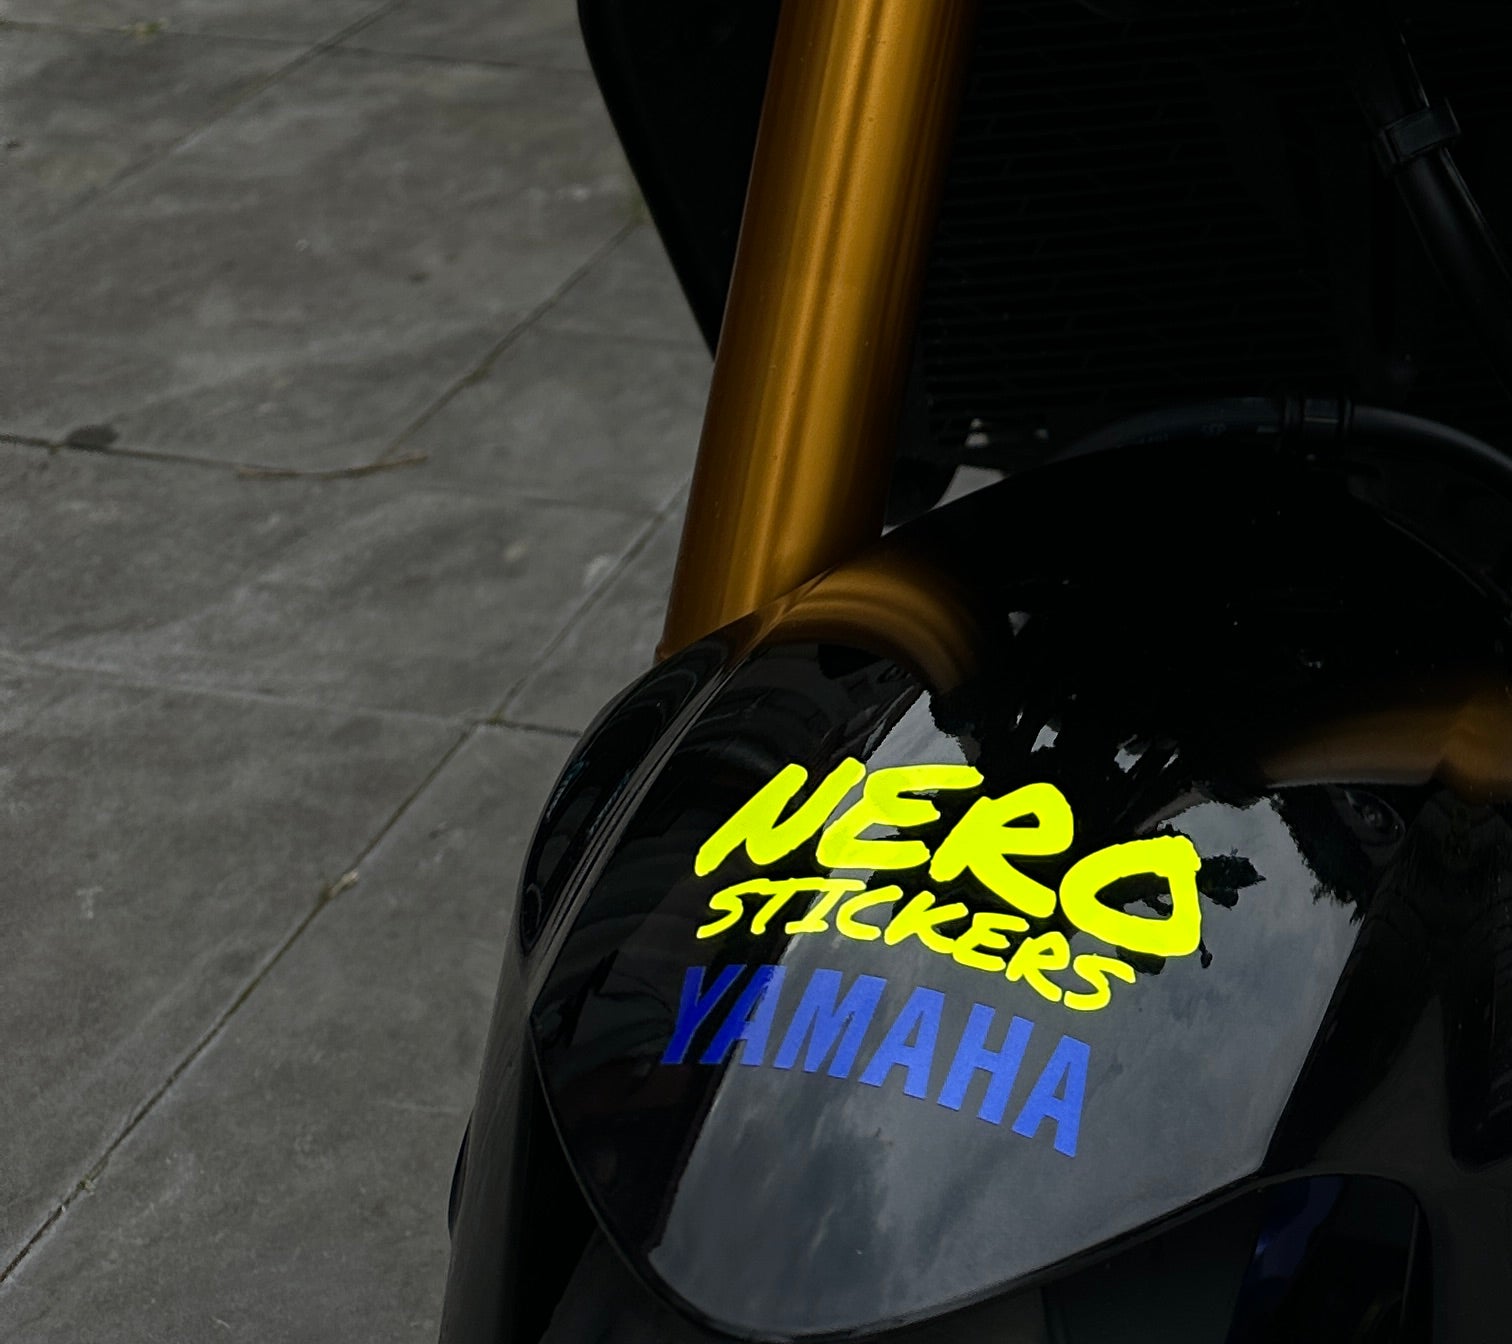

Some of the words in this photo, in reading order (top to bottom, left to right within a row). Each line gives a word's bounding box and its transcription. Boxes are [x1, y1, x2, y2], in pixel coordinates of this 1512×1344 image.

[695, 758, 1202, 957] NERO
[697, 876, 1136, 1011] STICKERS
[661, 964, 1091, 1159] YAMAHA
